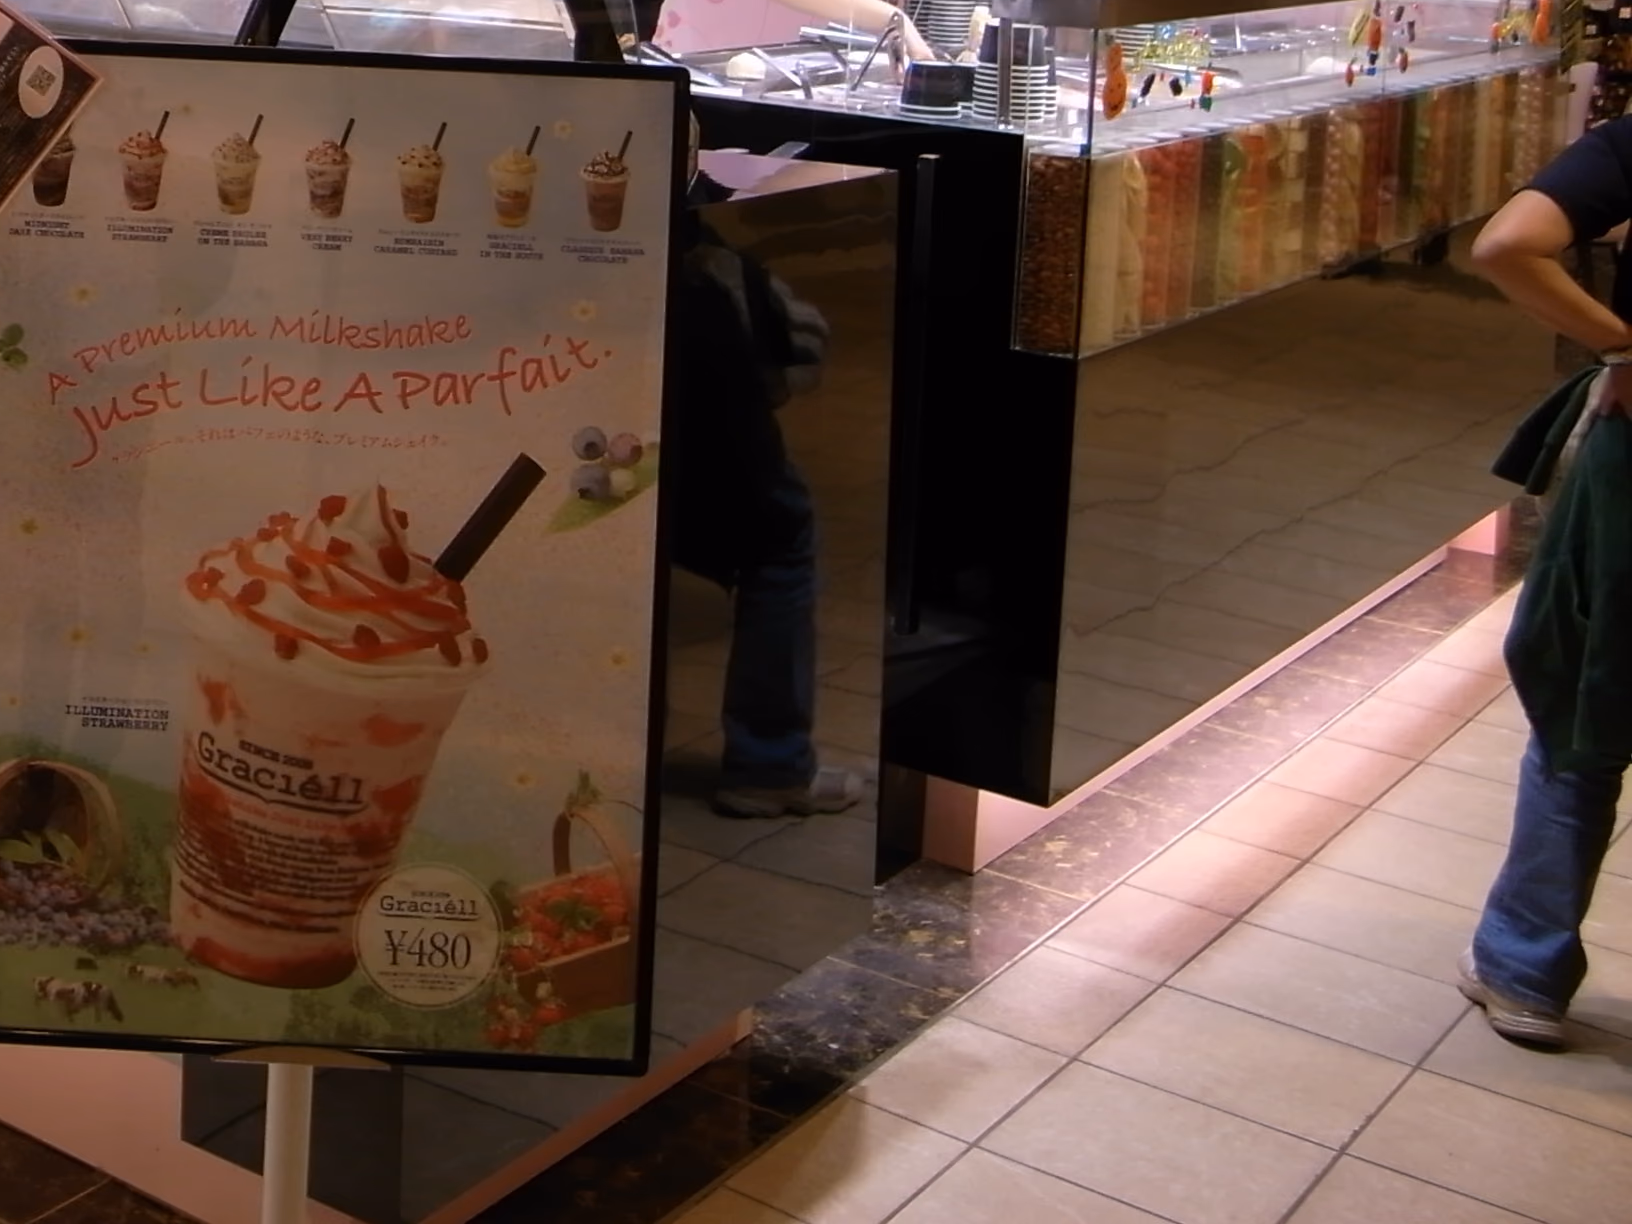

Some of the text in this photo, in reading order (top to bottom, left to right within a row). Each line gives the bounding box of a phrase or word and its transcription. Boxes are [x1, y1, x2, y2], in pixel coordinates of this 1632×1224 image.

[48, 307, 472, 405] A Premium Milkshake
[198, 356, 323, 413] Like
[332, 370, 384, 414] A
[395, 333, 613, 416] Parfait.
[64, 704, 170, 720] ILLUMINATION
[81, 718, 170, 732] STRAWBERRY
[384, 927, 472, 970] ¥480
